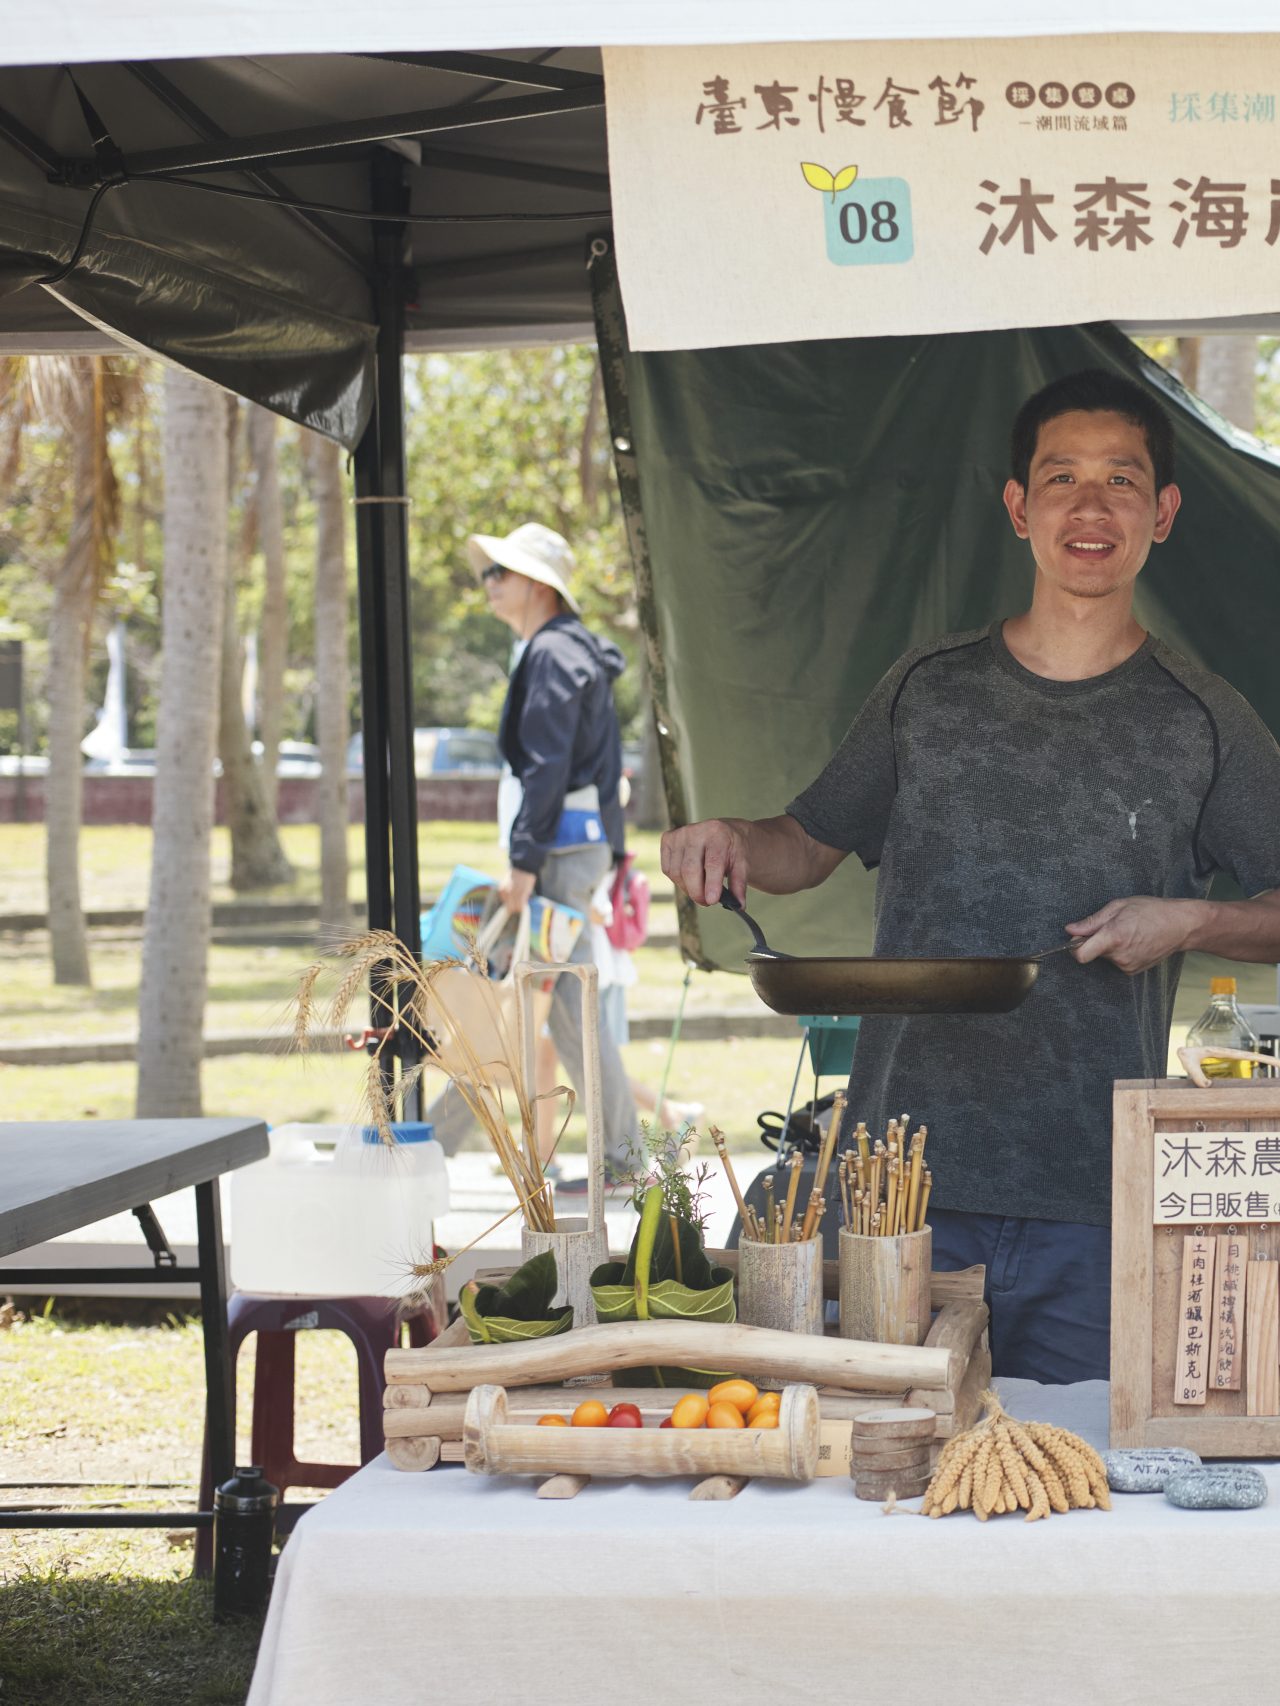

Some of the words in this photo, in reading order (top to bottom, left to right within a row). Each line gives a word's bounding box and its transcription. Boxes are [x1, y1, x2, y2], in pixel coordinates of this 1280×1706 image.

[695, 72, 985, 135] 臺東慢食節
[1008, 84, 1132, 106] 採集餐桌
[839, 201, 900, 244] 08
